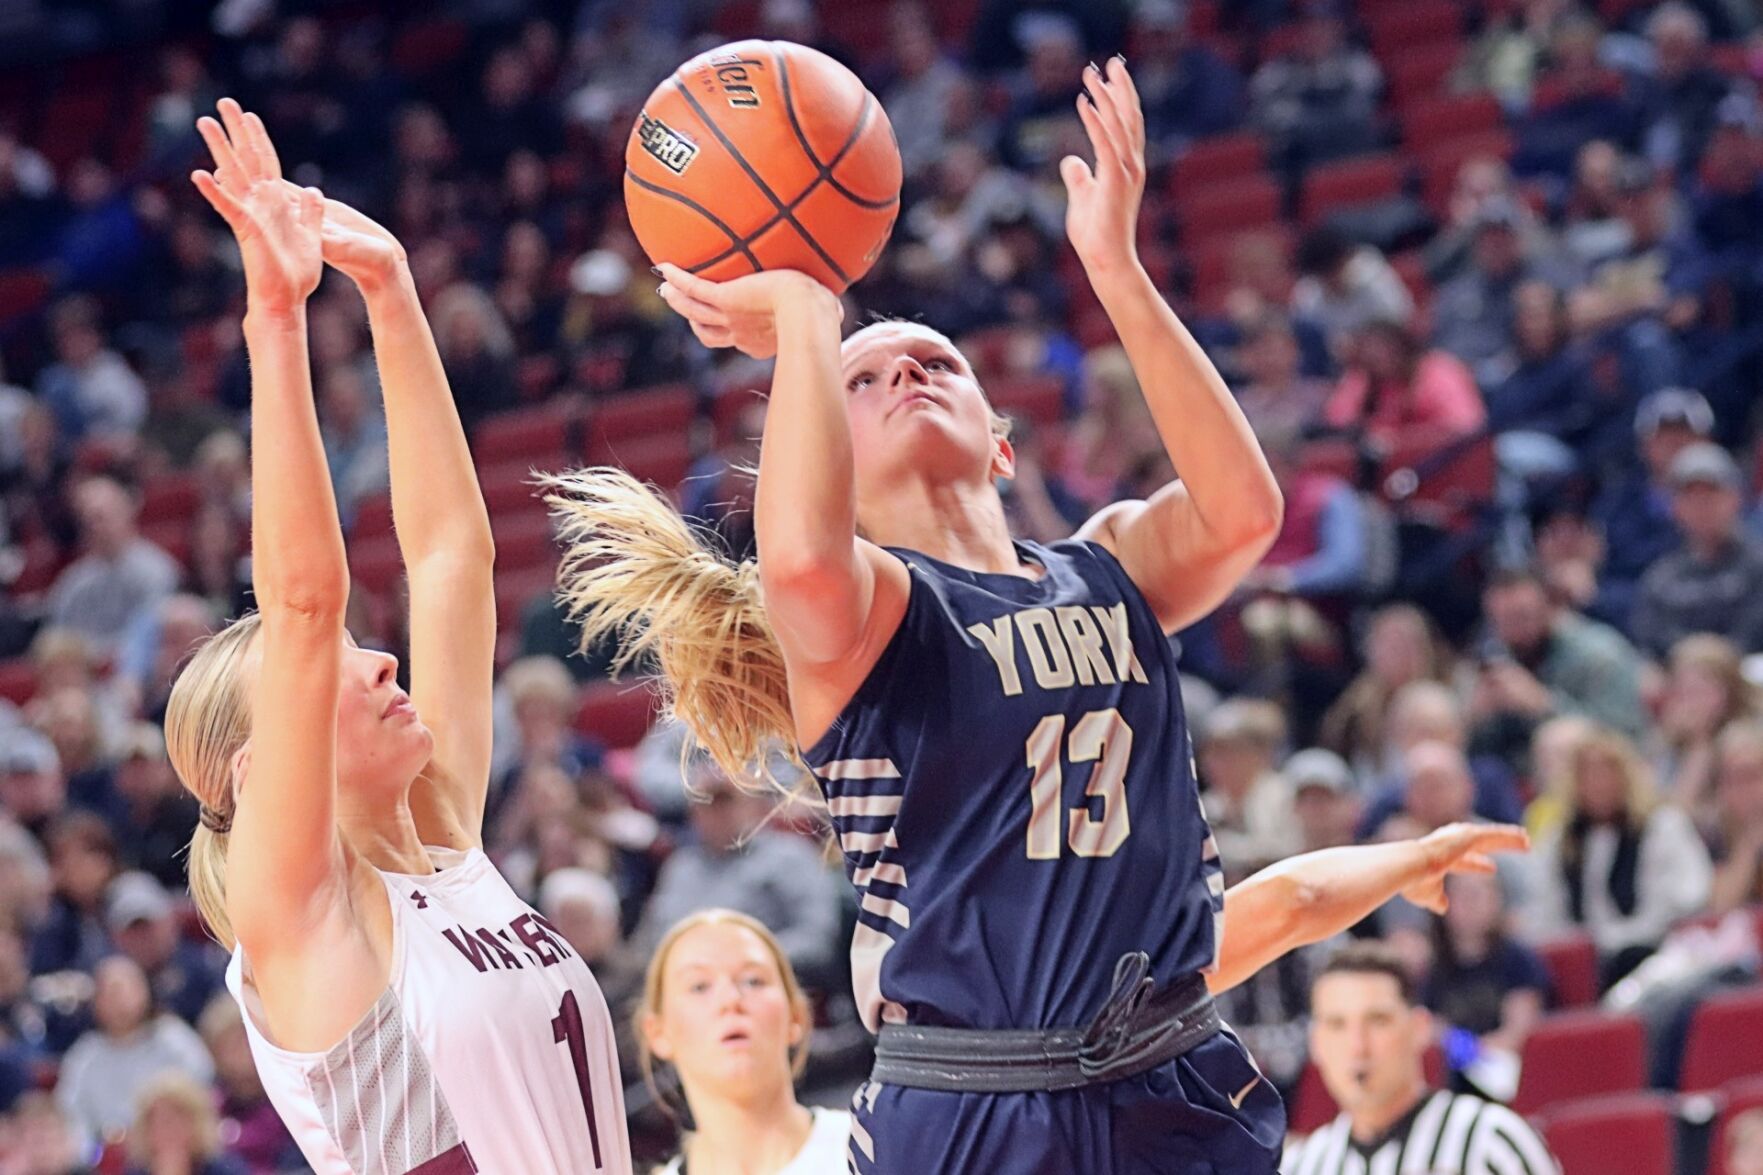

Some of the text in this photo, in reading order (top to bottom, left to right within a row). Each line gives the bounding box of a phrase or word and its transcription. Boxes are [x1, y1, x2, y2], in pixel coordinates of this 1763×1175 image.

[650, 127, 693, 170] PRO
[967, 601, 1149, 696] YORK
[1025, 707, 1133, 859] 13
[551, 989, 602, 1169] 1
